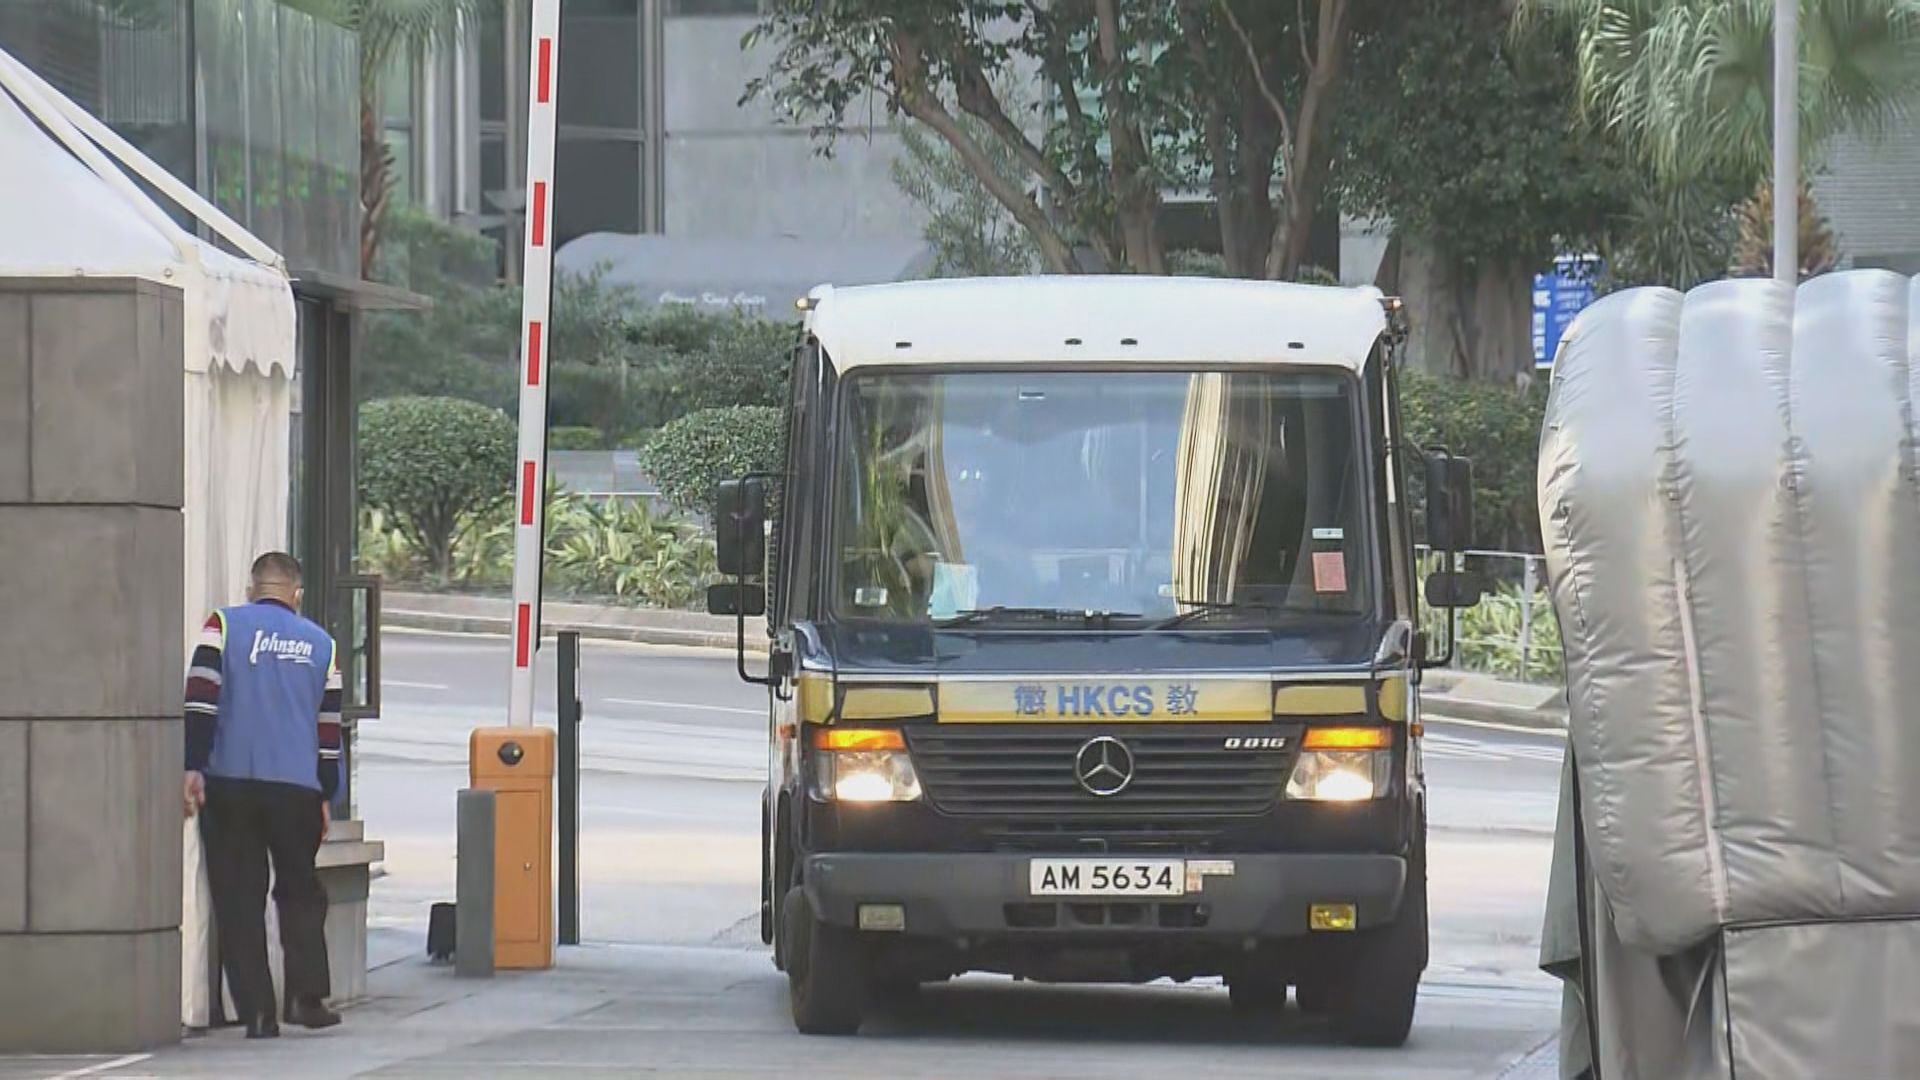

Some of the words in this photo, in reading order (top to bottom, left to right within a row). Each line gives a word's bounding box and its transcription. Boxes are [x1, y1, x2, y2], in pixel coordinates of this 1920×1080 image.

[249, 630, 313, 664] Johnson
[1058, 685, 1154, 716] HKCS
[1041, 865, 1080, 890] AM
[1091, 865, 1173, 890] 5634
